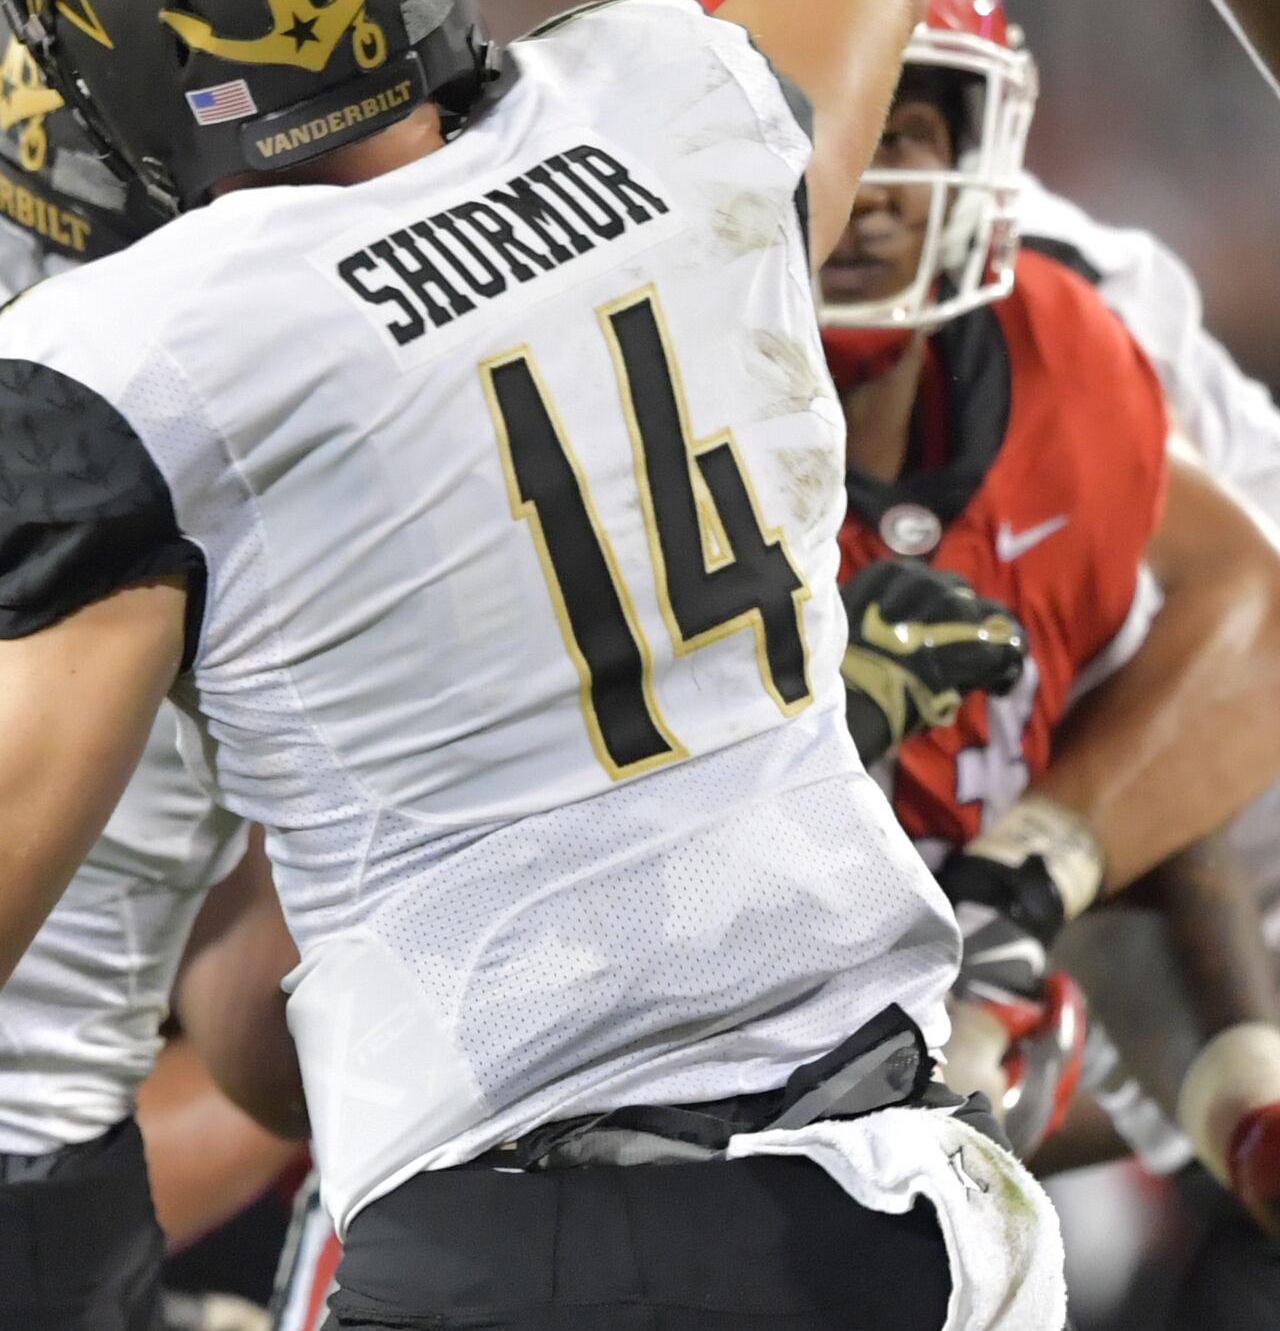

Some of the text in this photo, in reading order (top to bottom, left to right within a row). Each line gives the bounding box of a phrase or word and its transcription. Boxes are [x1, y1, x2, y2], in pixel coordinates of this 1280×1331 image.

[255, 79, 411, 158] VANDERBILT
[336, 144, 671, 347] SHURMUR
[477, 281, 814, 782] 14
